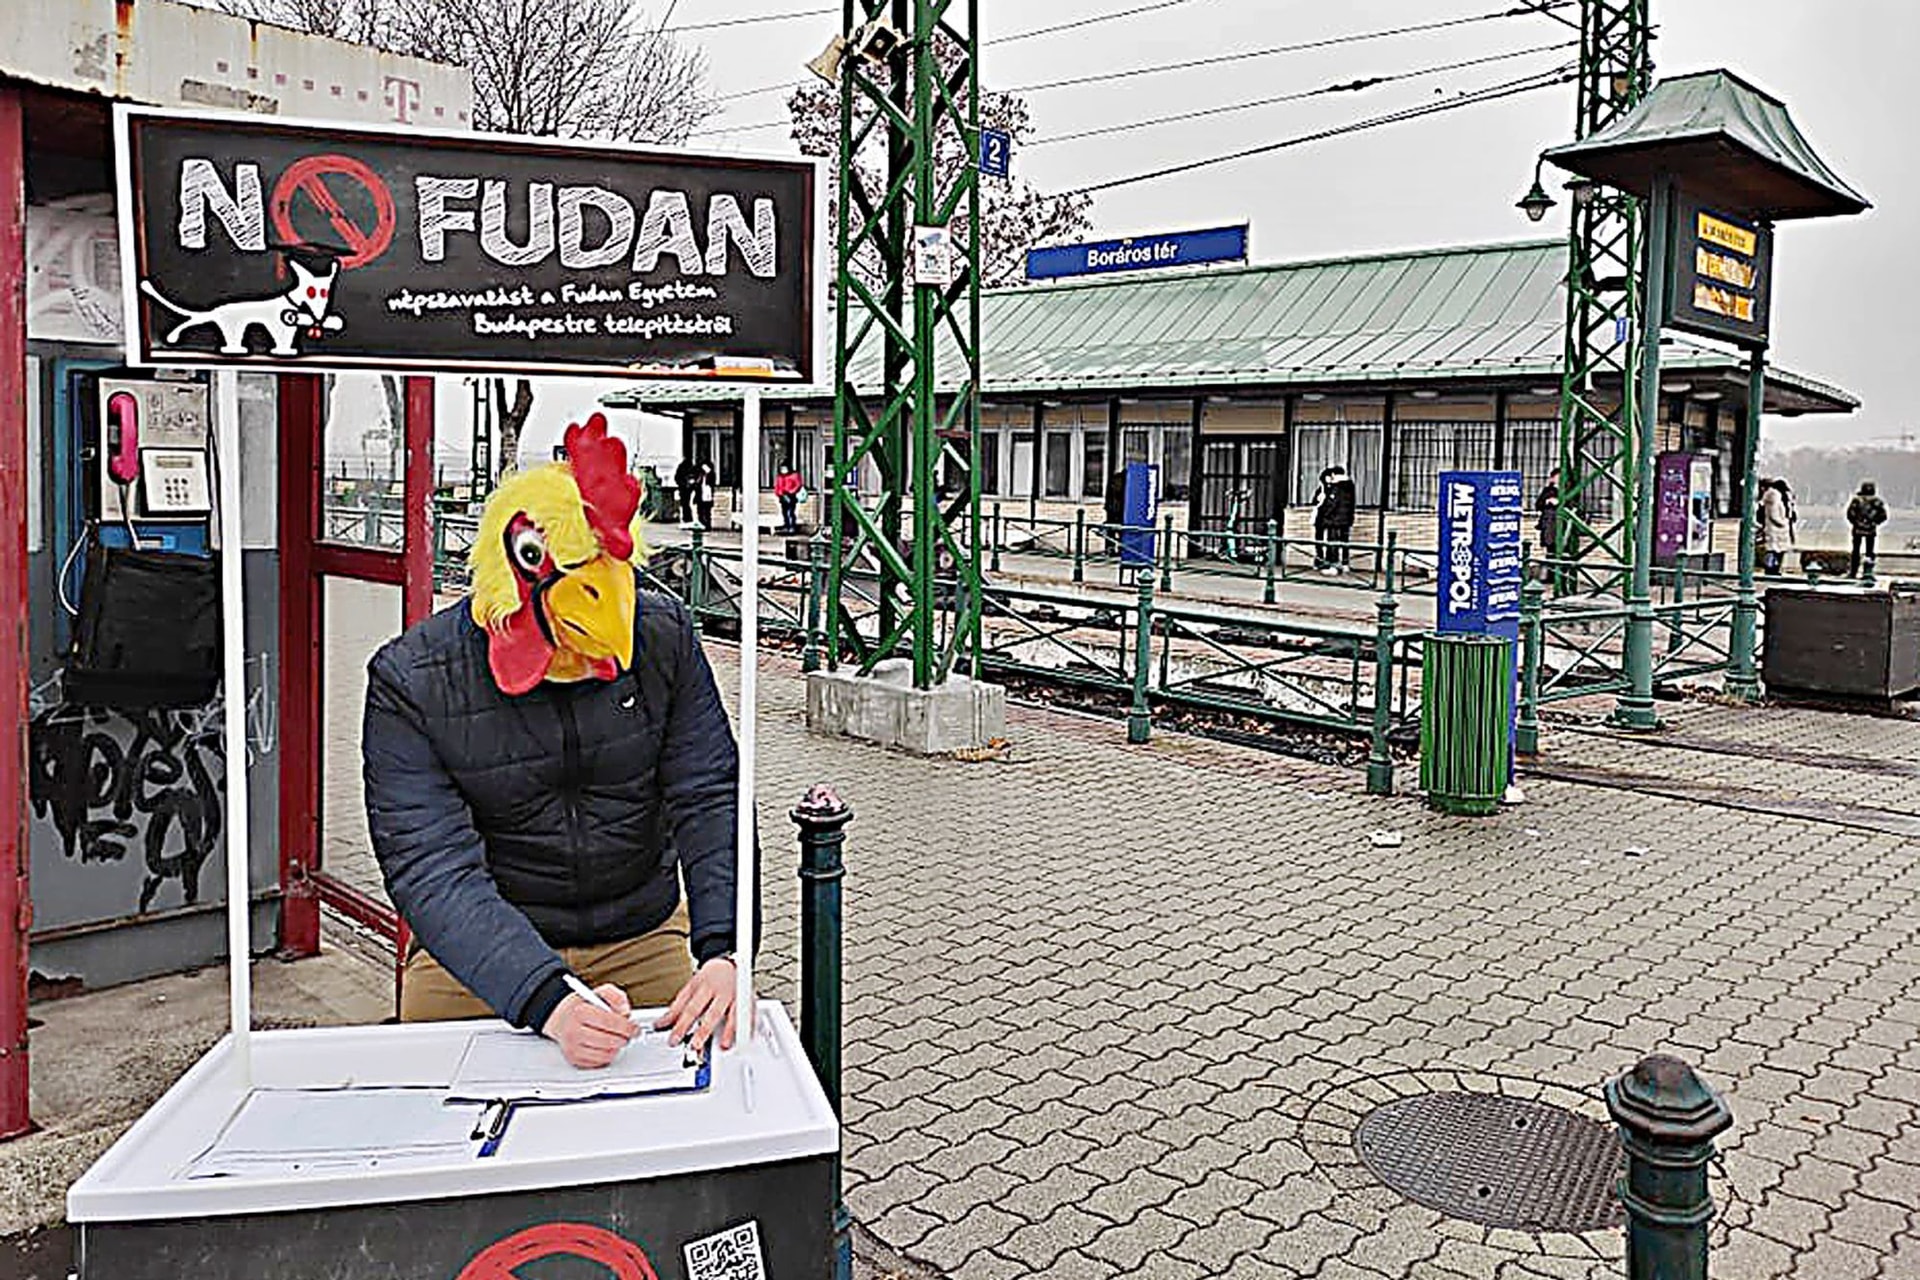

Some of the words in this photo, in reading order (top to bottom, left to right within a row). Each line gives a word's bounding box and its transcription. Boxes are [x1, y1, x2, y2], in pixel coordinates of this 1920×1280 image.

[384, 76, 420, 124] T
[988, 138, 1002, 163] 2
[415, 176, 776, 277] FUDAN
[1087, 247, 1151, 267] Boráros
[1154, 242, 1178, 260] tér
[388, 285, 534, 316] népszavazást
[540, 290, 556, 304] a
[561, 283, 623, 304] Fudan
[628, 280, 717, 308] Egyetem
[473, 311, 597, 340] Budapestre
[1449, 483, 1475, 614] METROPOL
